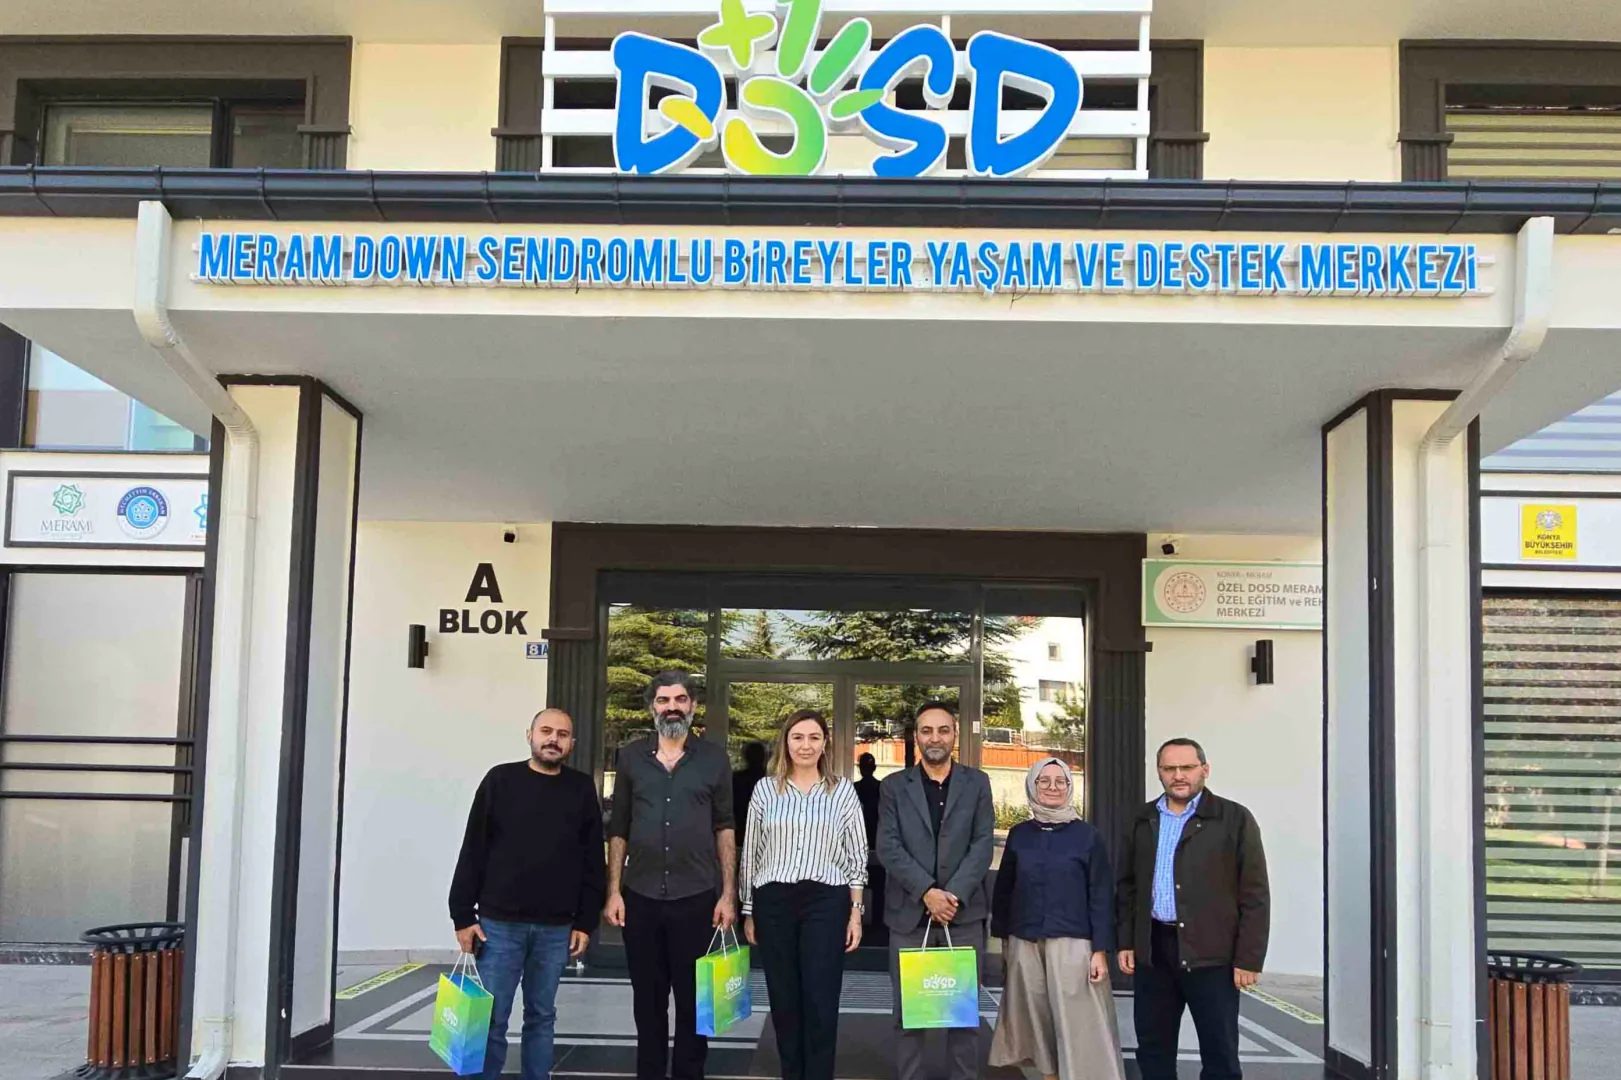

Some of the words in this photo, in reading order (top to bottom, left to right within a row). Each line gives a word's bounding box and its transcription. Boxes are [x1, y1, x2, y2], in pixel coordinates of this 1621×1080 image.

[199, 233, 342, 279] MERAM
[352, 235, 465, 280] DOWN
[476, 236, 712, 283] SENDROMLU
[723, 239, 913, 286] BİREYLER
[927, 241, 1063, 290] YAŞAM
[1075, 242, 1125, 288] VE
[1136, 242, 1287, 289] DESTEK
[1301, 244, 1476, 290] MERKEZİ
[464, 562, 503, 603] A
[1217, 581, 1245, 593] ÖZEL
[1248, 583, 1281, 593] DOSD
[1217, 594, 1245, 605] ÖZEL
[1248, 594, 1286, 606] EĞİTİM
[1289, 598, 1302, 606] ve
[1217, 606, 1265, 617] MERKEZİ
[439, 608, 528, 635] BLOK
